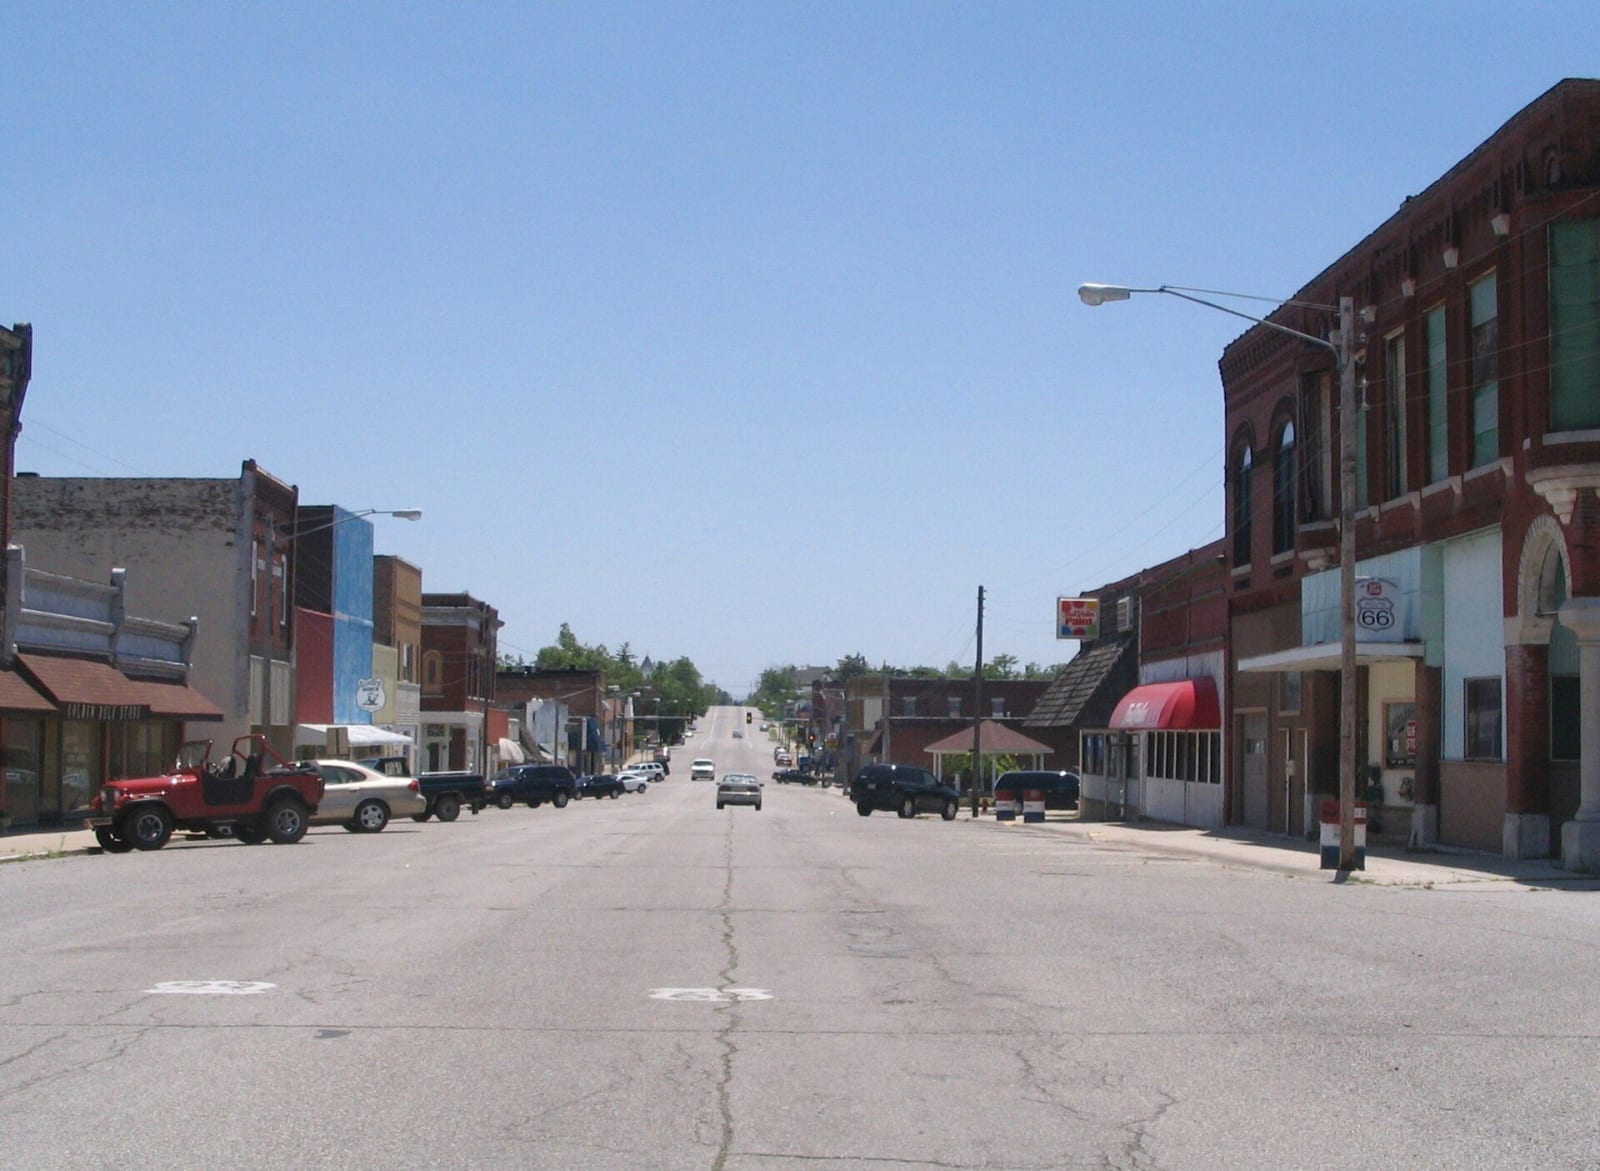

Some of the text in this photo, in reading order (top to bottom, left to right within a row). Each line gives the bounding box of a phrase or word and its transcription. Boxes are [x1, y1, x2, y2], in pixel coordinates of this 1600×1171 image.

[1065, 618, 1092, 626] Paint
[1362, 610, 1389, 625] 66
[68, 704, 95, 720] GOLDEN
[120, 705, 141, 720] STORE
